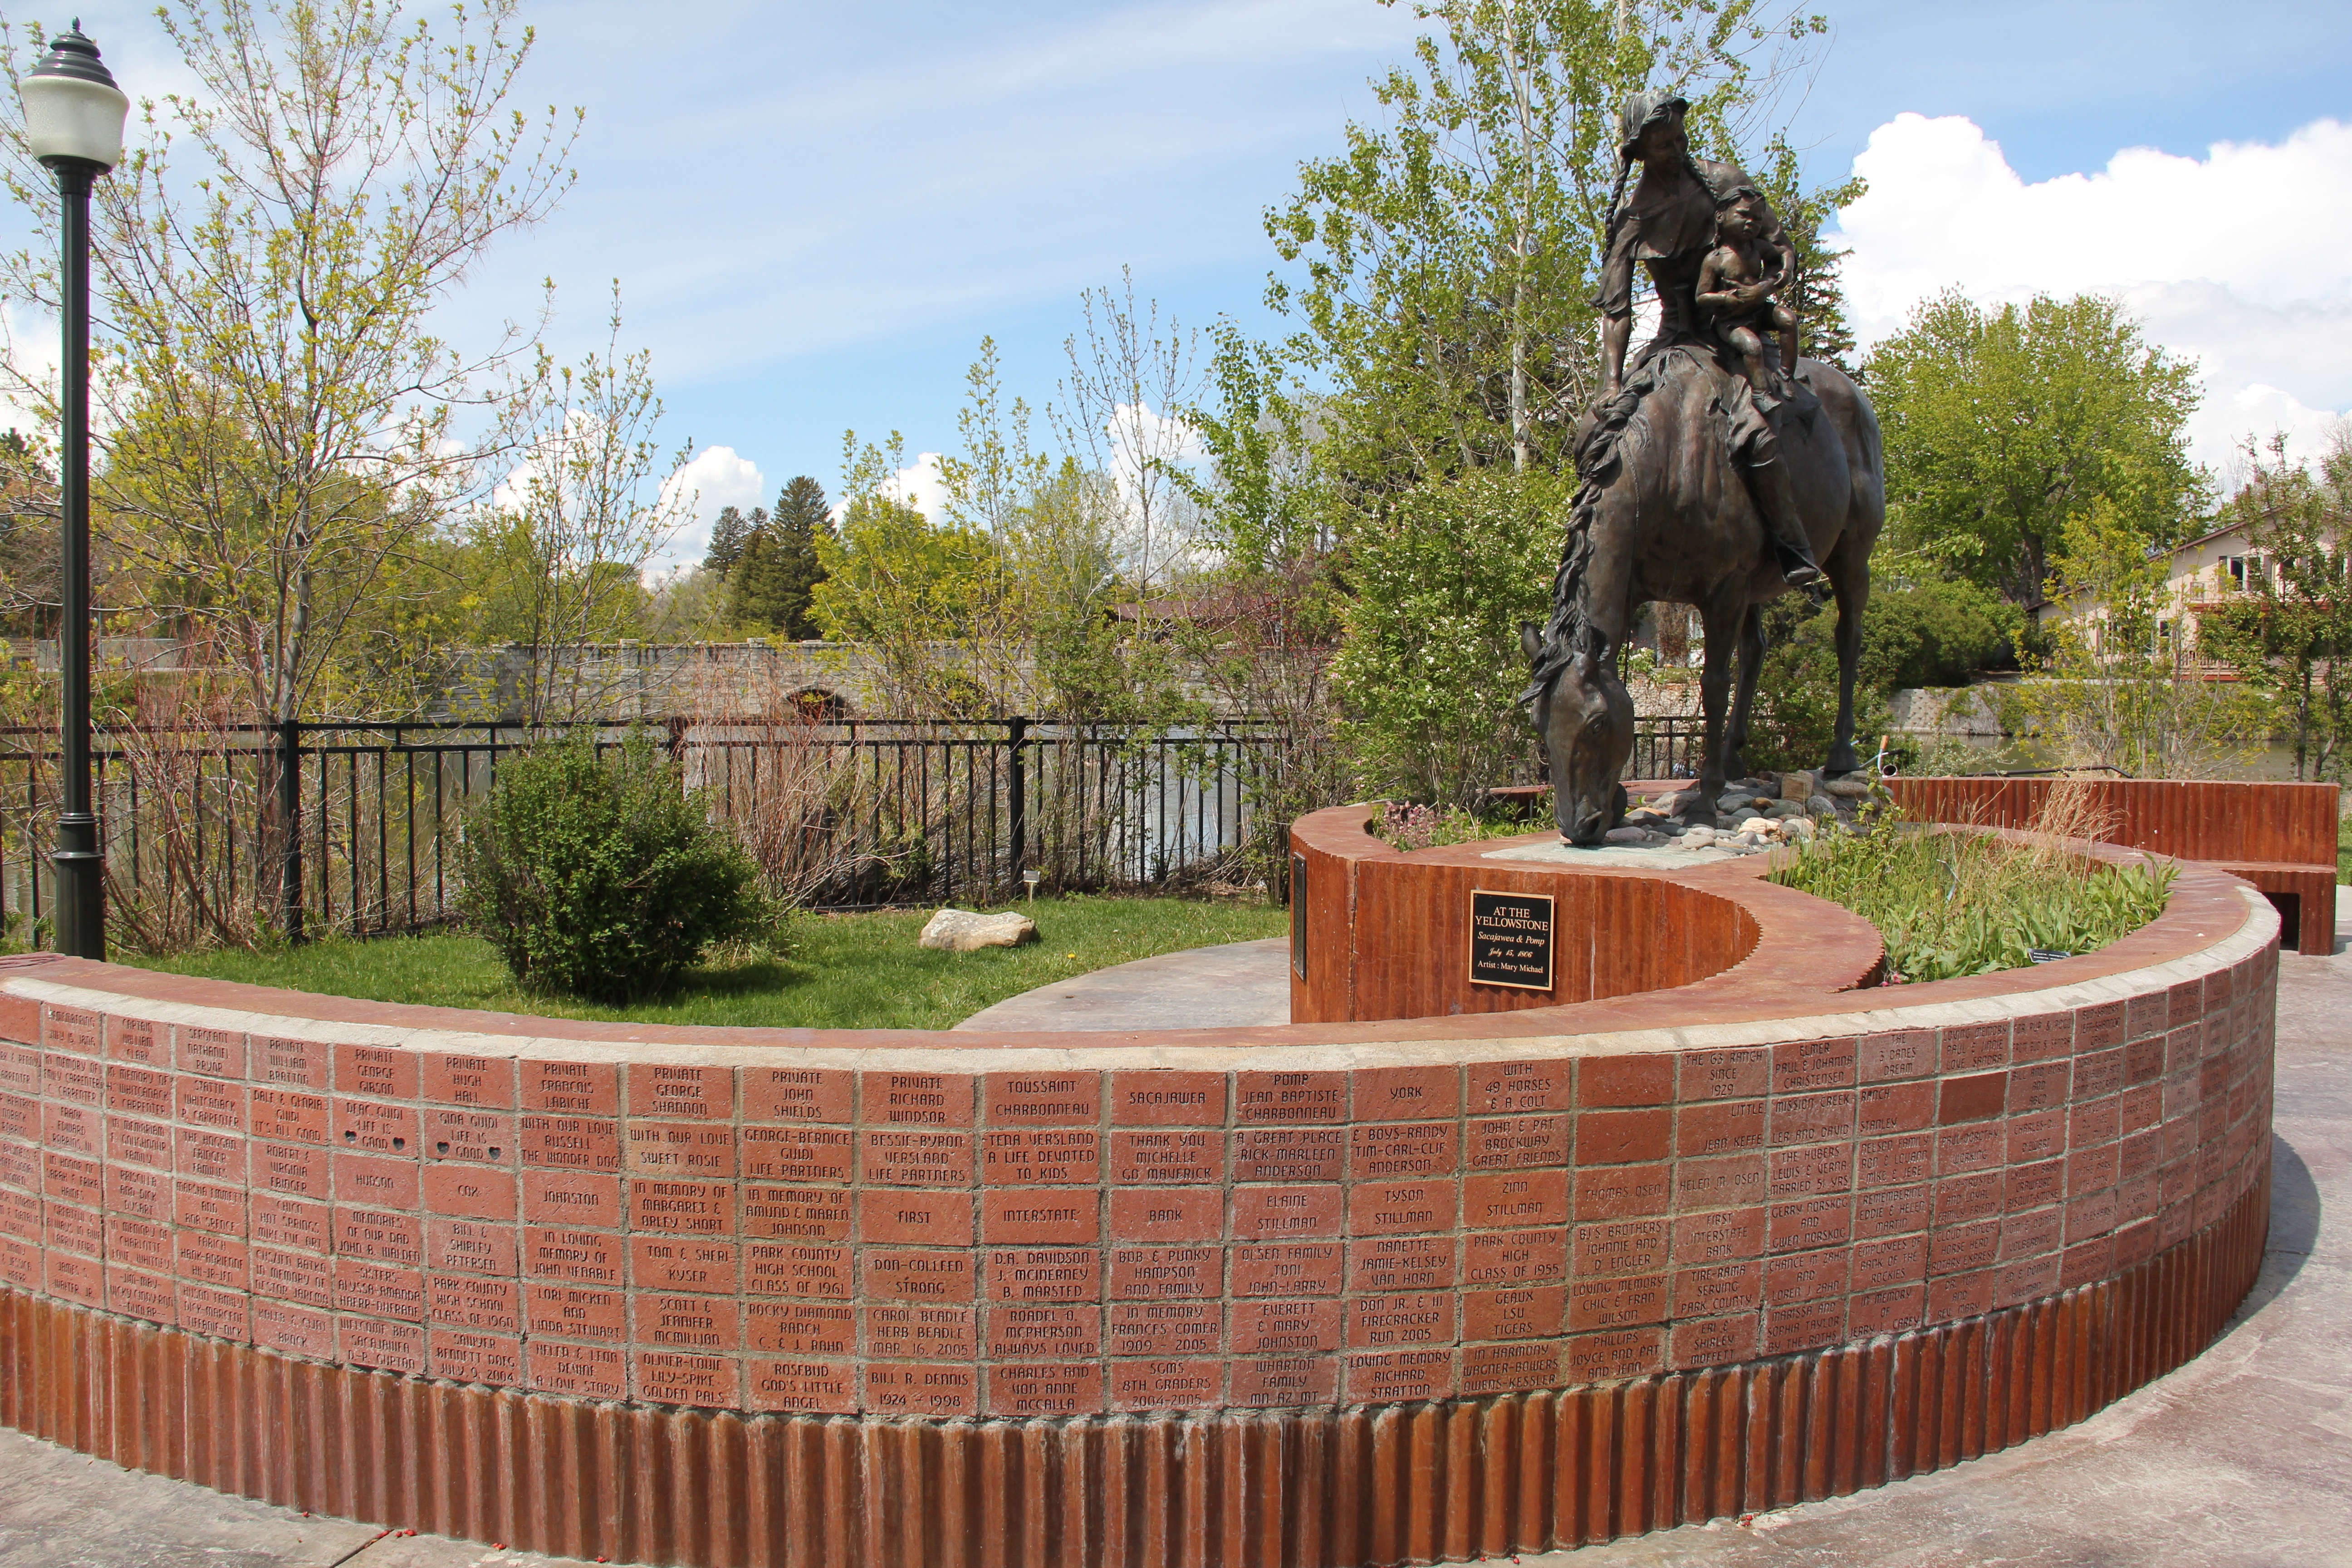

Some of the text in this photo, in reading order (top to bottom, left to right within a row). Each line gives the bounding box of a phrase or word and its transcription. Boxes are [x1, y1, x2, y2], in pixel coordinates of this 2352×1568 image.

[1493, 907, 1530, 918] AT THE
[1475, 916, 1548, 931] YELLOWSTONE
[1478, 931, 1514, 942] Sacajawea
[1525, 936, 1544, 946] Pomp
[1488, 947, 1502, 957] July
[1501, 962, 1518, 972] Mary
[1519, 964, 1543, 973] Michael
[122, 1019, 152, 1032] CAPTAIN
[189, 1029, 228, 1043] SERGEANT
[1891, 1034, 1906, 1044] THE
[188, 1044, 229, 1059] NATHANIEL
[270, 1040, 304, 1054] PRIVATE
[126, 1049, 150, 1061] CLARK
[356, 1049, 394, 1063] PRIVATE
[1686, 1050, 1762, 1066] THE 63 RANCH
[196, 1060, 222, 1073] PRYOR
[270, 1055, 307, 1069] WILLIAM
[446, 1058, 487, 1071] PRIVATE
[358, 1066, 394, 1079] GEORGE
[544, 1064, 589, 1077] PRIVATE
[654, 1068, 702, 1082] PRIVATE
[1504, 1064, 1532, 1076] WITH
[1710, 1069, 1737, 1080] SINCE
[1884, 1064, 1913, 1075] DREAM
[269, 1071, 309, 1085] BRATTON
[454, 1075, 481, 1086] HUGH
[773, 1071, 822, 1084] PRIVATE
[892, 1076, 943, 1090] PRIVATE
[1269, 1074, 1314, 1086] "POMP"
[359, 1081, 394, 1095] GIBSON
[541, 1080, 593, 1094] FRANCOIS
[657, 1084, 702, 1098] GEORGE
[1008, 1081, 1076, 1093] TOUSSAINT
[1485, 1079, 1551, 1093] 49 HORSES
[1711, 1084, 1734, 1097] 1929
[455, 1091, 480, 1103] HALL
[783, 1088, 813, 1100] JOHN
[890, 1093, 944, 1107] RICHARD
[1130, 1092, 1205, 1104] SACAJAWEA
[1243, 1090, 1338, 1104] JEAN BAPTISTE
[1390, 1087, 1422, 1100] YORK
[545, 1097, 591, 1110] LABICHE
[652, 1101, 707, 1116] SHANNON
[1491, 1095, 1545, 1109] & A COLT
[774, 1105, 822, 1118] SHIELDS
[995, 1103, 1089, 1117] CHARBONNEAU
[1246, 1107, 1336, 1121] CHARBONNEAU
[440, 1113, 498, 1128] GINA GUIDI
[889, 1111, 946, 1123] WINDSOR
[451, 1130, 487, 1143] LIFE IS
[745, 1128, 849, 1145] GEORGE-BERNICE
[1130, 1135, 1205, 1147] THANK YOU
[456, 1147, 484, 1159] GOOD
[781, 1148, 813, 1161] GUIDI
[1137, 1152, 1196, 1164] MICHELLE
[750, 1163, 844, 1179] LIFE PARTNERS
[1122, 1167, 1212, 1181] GO MAVERICK
[357, 1175, 393, 1188] HUDSON
[1503, 1181, 1528, 1194] ZINN
[1680, 1176, 1710, 1191] HELEN
[1735, 1172, 1759, 1185] OSEN
[458, 1185, 479, 1197] COX
[1385, 1190, 1423, 1202] TYSON
[1585, 1185, 1661, 1201] THOMAS OSEN
[544, 1191, 598, 1205] JOHNSTON
[1267, 1195, 1308, 1207] ELAINE
[1004, 1209, 1077, 1222] INTERSTATE
[1487, 1202, 1542, 1216] STILLMAN
[898, 1211, 931, 1224] FIRST
[1150, 1210, 1182, 1222] BANK
[1375, 1210, 1433, 1224] STILLMAN
[1707, 1213, 1733, 1225] FIRST
[1258, 1217, 1317, 1230] STILLMAN
[1580, 1221, 1661, 1240] BJ'S BROTHERS
[1691, 1228, 1748, 1243] INTERSTATE
[752, 1246, 841, 1262] PARK COUNTY
[1587, 1239, 1657, 1256] JOHNNIE AND
[1707, 1245, 1732, 1257] BANK
[995, 1252, 1089, 1265] D.A. DAVIDSON
[1612, 1254, 1651, 1269] ENGLER
[755, 1263, 838, 1277] HIGH SCHOOL
[875, 1259, 963, 1272] DON-COLLEEN
[998, 1269, 1088, 1282] J. MCINERNEY
[752, 1279, 844, 1295] CLASS OF 1961
[896, 1282, 945, 1294] STRONG
[1004, 1286, 1082, 1298] B. MARSTED
[1495, 1292, 1534, 1305] GEAUX
[1127, 1307, 1202, 1318] IN MEMORY
[1504, 1308, 1524, 1320] LSU
[1112, 1323, 1217, 1335] FRANCES COMER
[1494, 1322, 1533, 1335] TIGERS
[1122, 1340, 1152, 1351] 1909
[1176, 1339, 1206, 1351] 2005
[1256, 1359, 1315, 1372] WHARTON
[1351, 1352, 1451, 1368] LOVING MEMORY
[872, 1372, 969, 1386] BILL R. DENNIS
[1001, 1367, 1088, 1380] CHARLES AND
[1374, 1369, 1425, 1382] RICHARD
[1263, 1376, 1307, 1387] FAMILY
[1013, 1383, 1078, 1396] VON ANNE
[1371, 1384, 1430, 1398] STRATTON
[880, 1393, 906, 1406] 1924
[930, 1395, 961, 1406] 1998
[1017, 1398, 1075, 1411] MCCALLA
[1250, 1392, 1318, 1404] MN AZ MT
